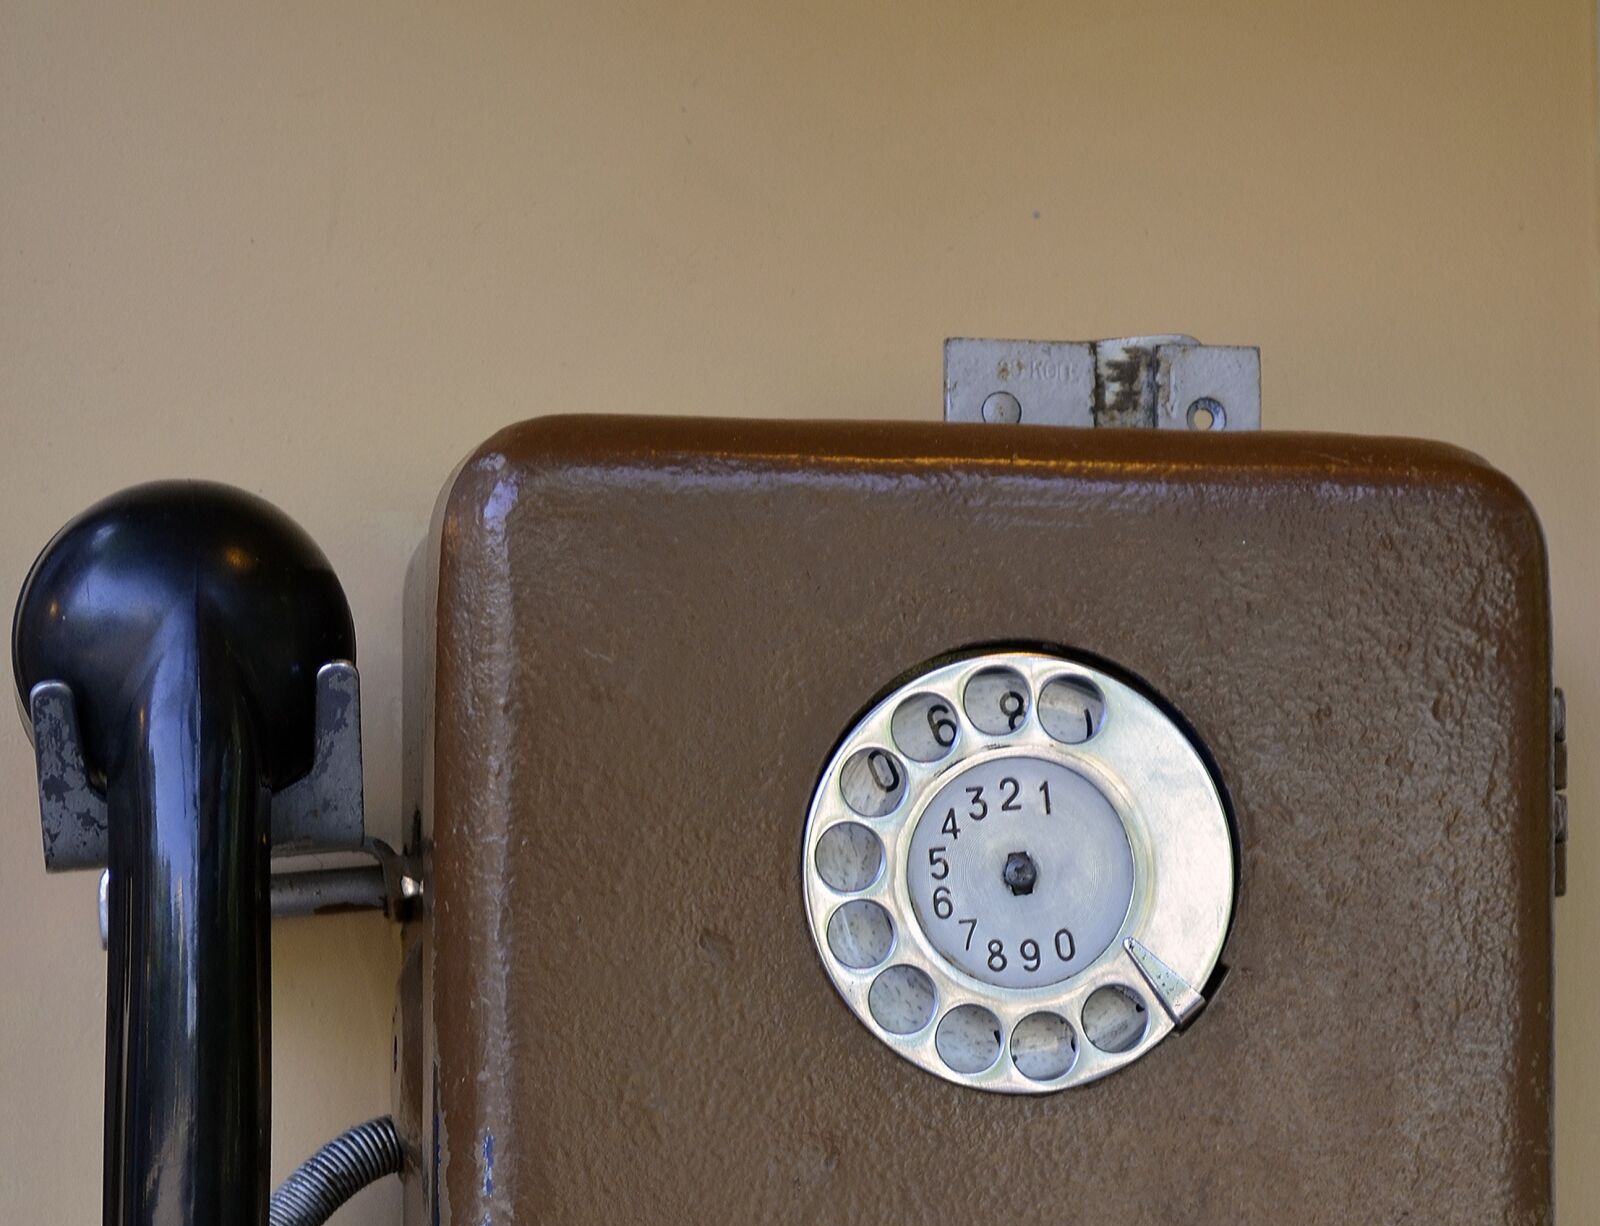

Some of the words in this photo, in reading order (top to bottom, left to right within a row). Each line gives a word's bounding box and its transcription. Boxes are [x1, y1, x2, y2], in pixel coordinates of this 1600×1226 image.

[965, 786, 989, 821] 3
[1000, 777, 1023, 812] 2
[1039, 781, 1052, 816] 1
[942, 808, 961, 840] 4
[929, 847, 950, 880] 5
[932, 887, 953, 920] 6
[959, 919, 978, 951] 7
[1055, 929, 1076, 962] 0
[988, 939, 1008, 972] 8
[1019, 938, 1041, 972] 9
